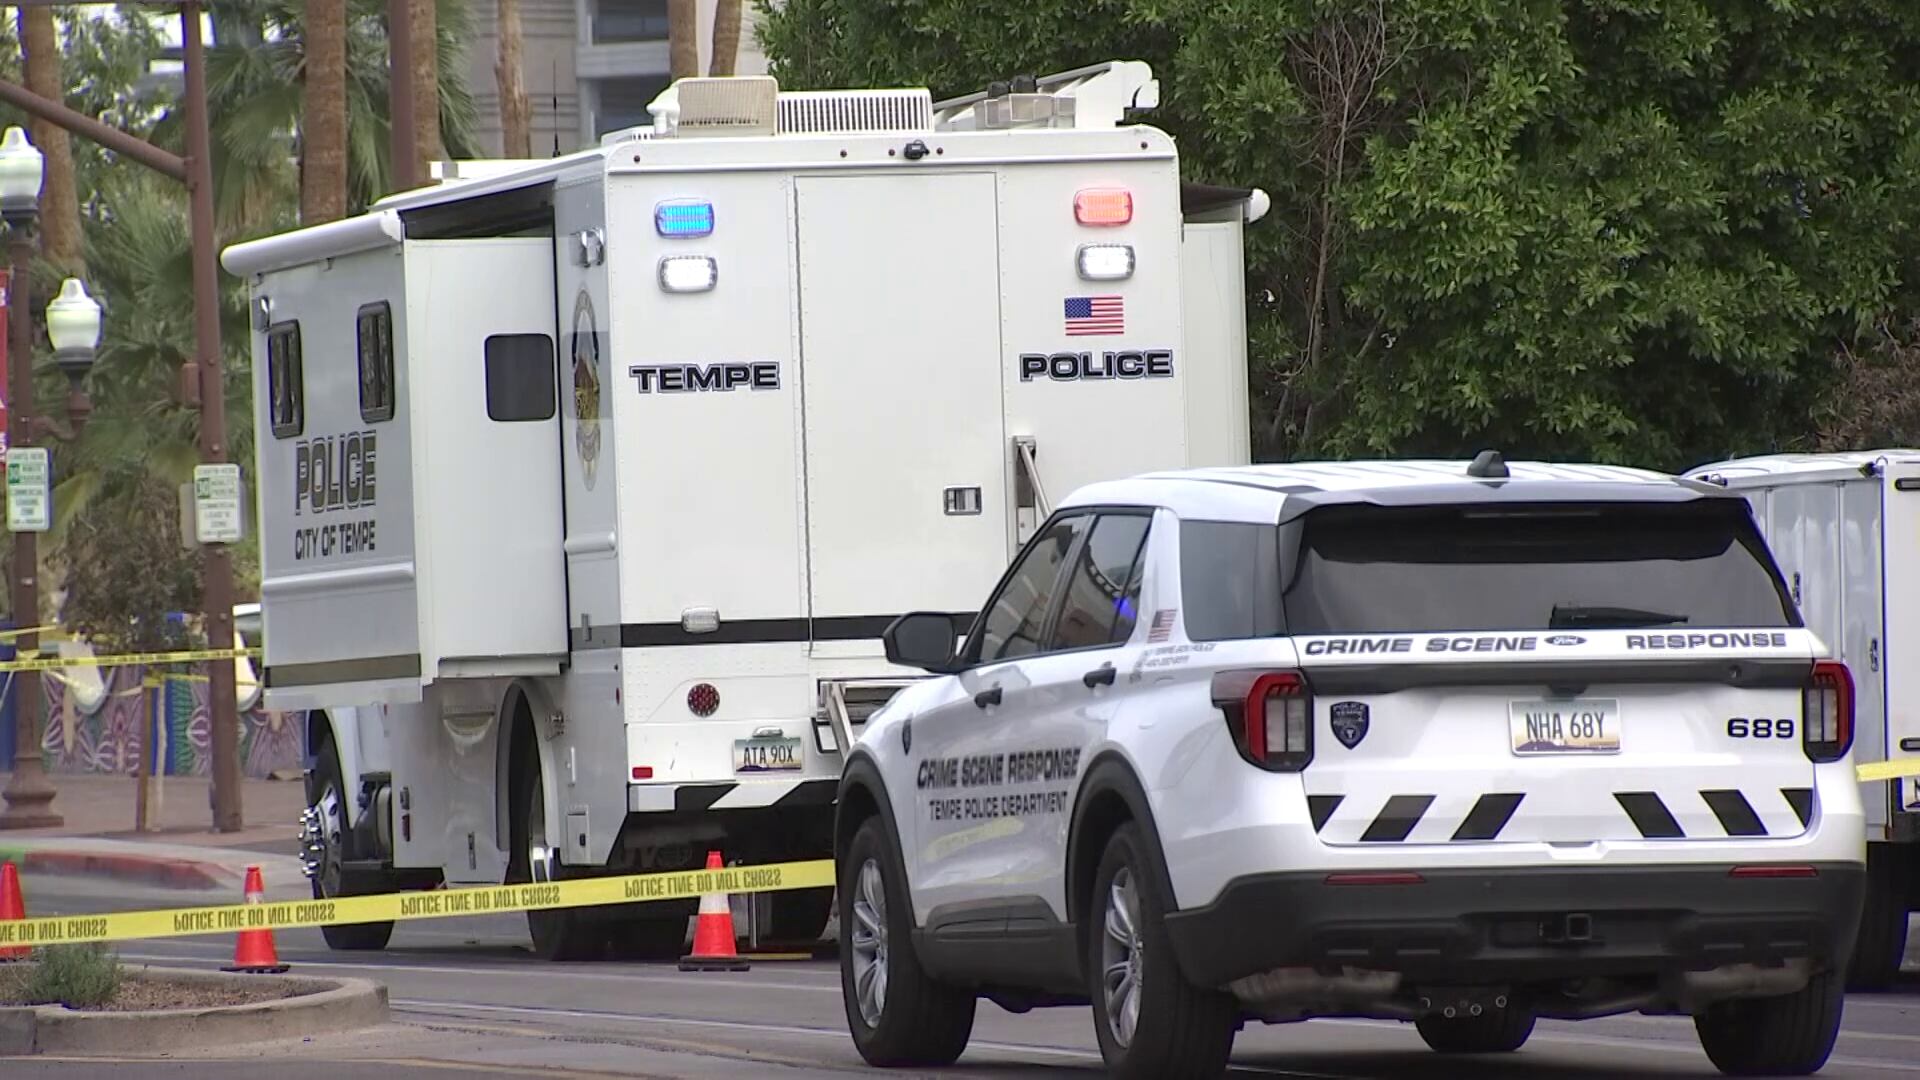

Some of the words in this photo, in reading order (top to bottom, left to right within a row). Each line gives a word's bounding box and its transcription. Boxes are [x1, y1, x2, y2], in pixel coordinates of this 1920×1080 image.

[629, 361, 781, 393] TEMPE
[1019, 349, 1174, 382] POLICE
[296, 429, 376, 516] POLICE
[296, 527, 319, 560] CITY
[321, 525, 336, 556] OF
[339, 520, 375, 554] TEMPE
[1305, 638, 1413, 656] CRIME
[1425, 636, 1537, 652] SCENE
[1626, 633, 1787, 649] RESPONSE
[1526, 712, 1563, 740] NHA
[1570, 711, 1604, 738] 68Y
[1727, 717, 1794, 739] 689
[744, 746, 766, 765] ATA
[771, 745, 793, 763] 90X
[917, 758, 959, 789] CRIME
[961, 753, 1004, 787] SCENE
[1008, 746, 1082, 783] RESPONSE
[929, 799, 961, 821] TEMPE
[965, 796, 999, 818] POLICE
[1002, 791, 1068, 817] DEPARTMENT
